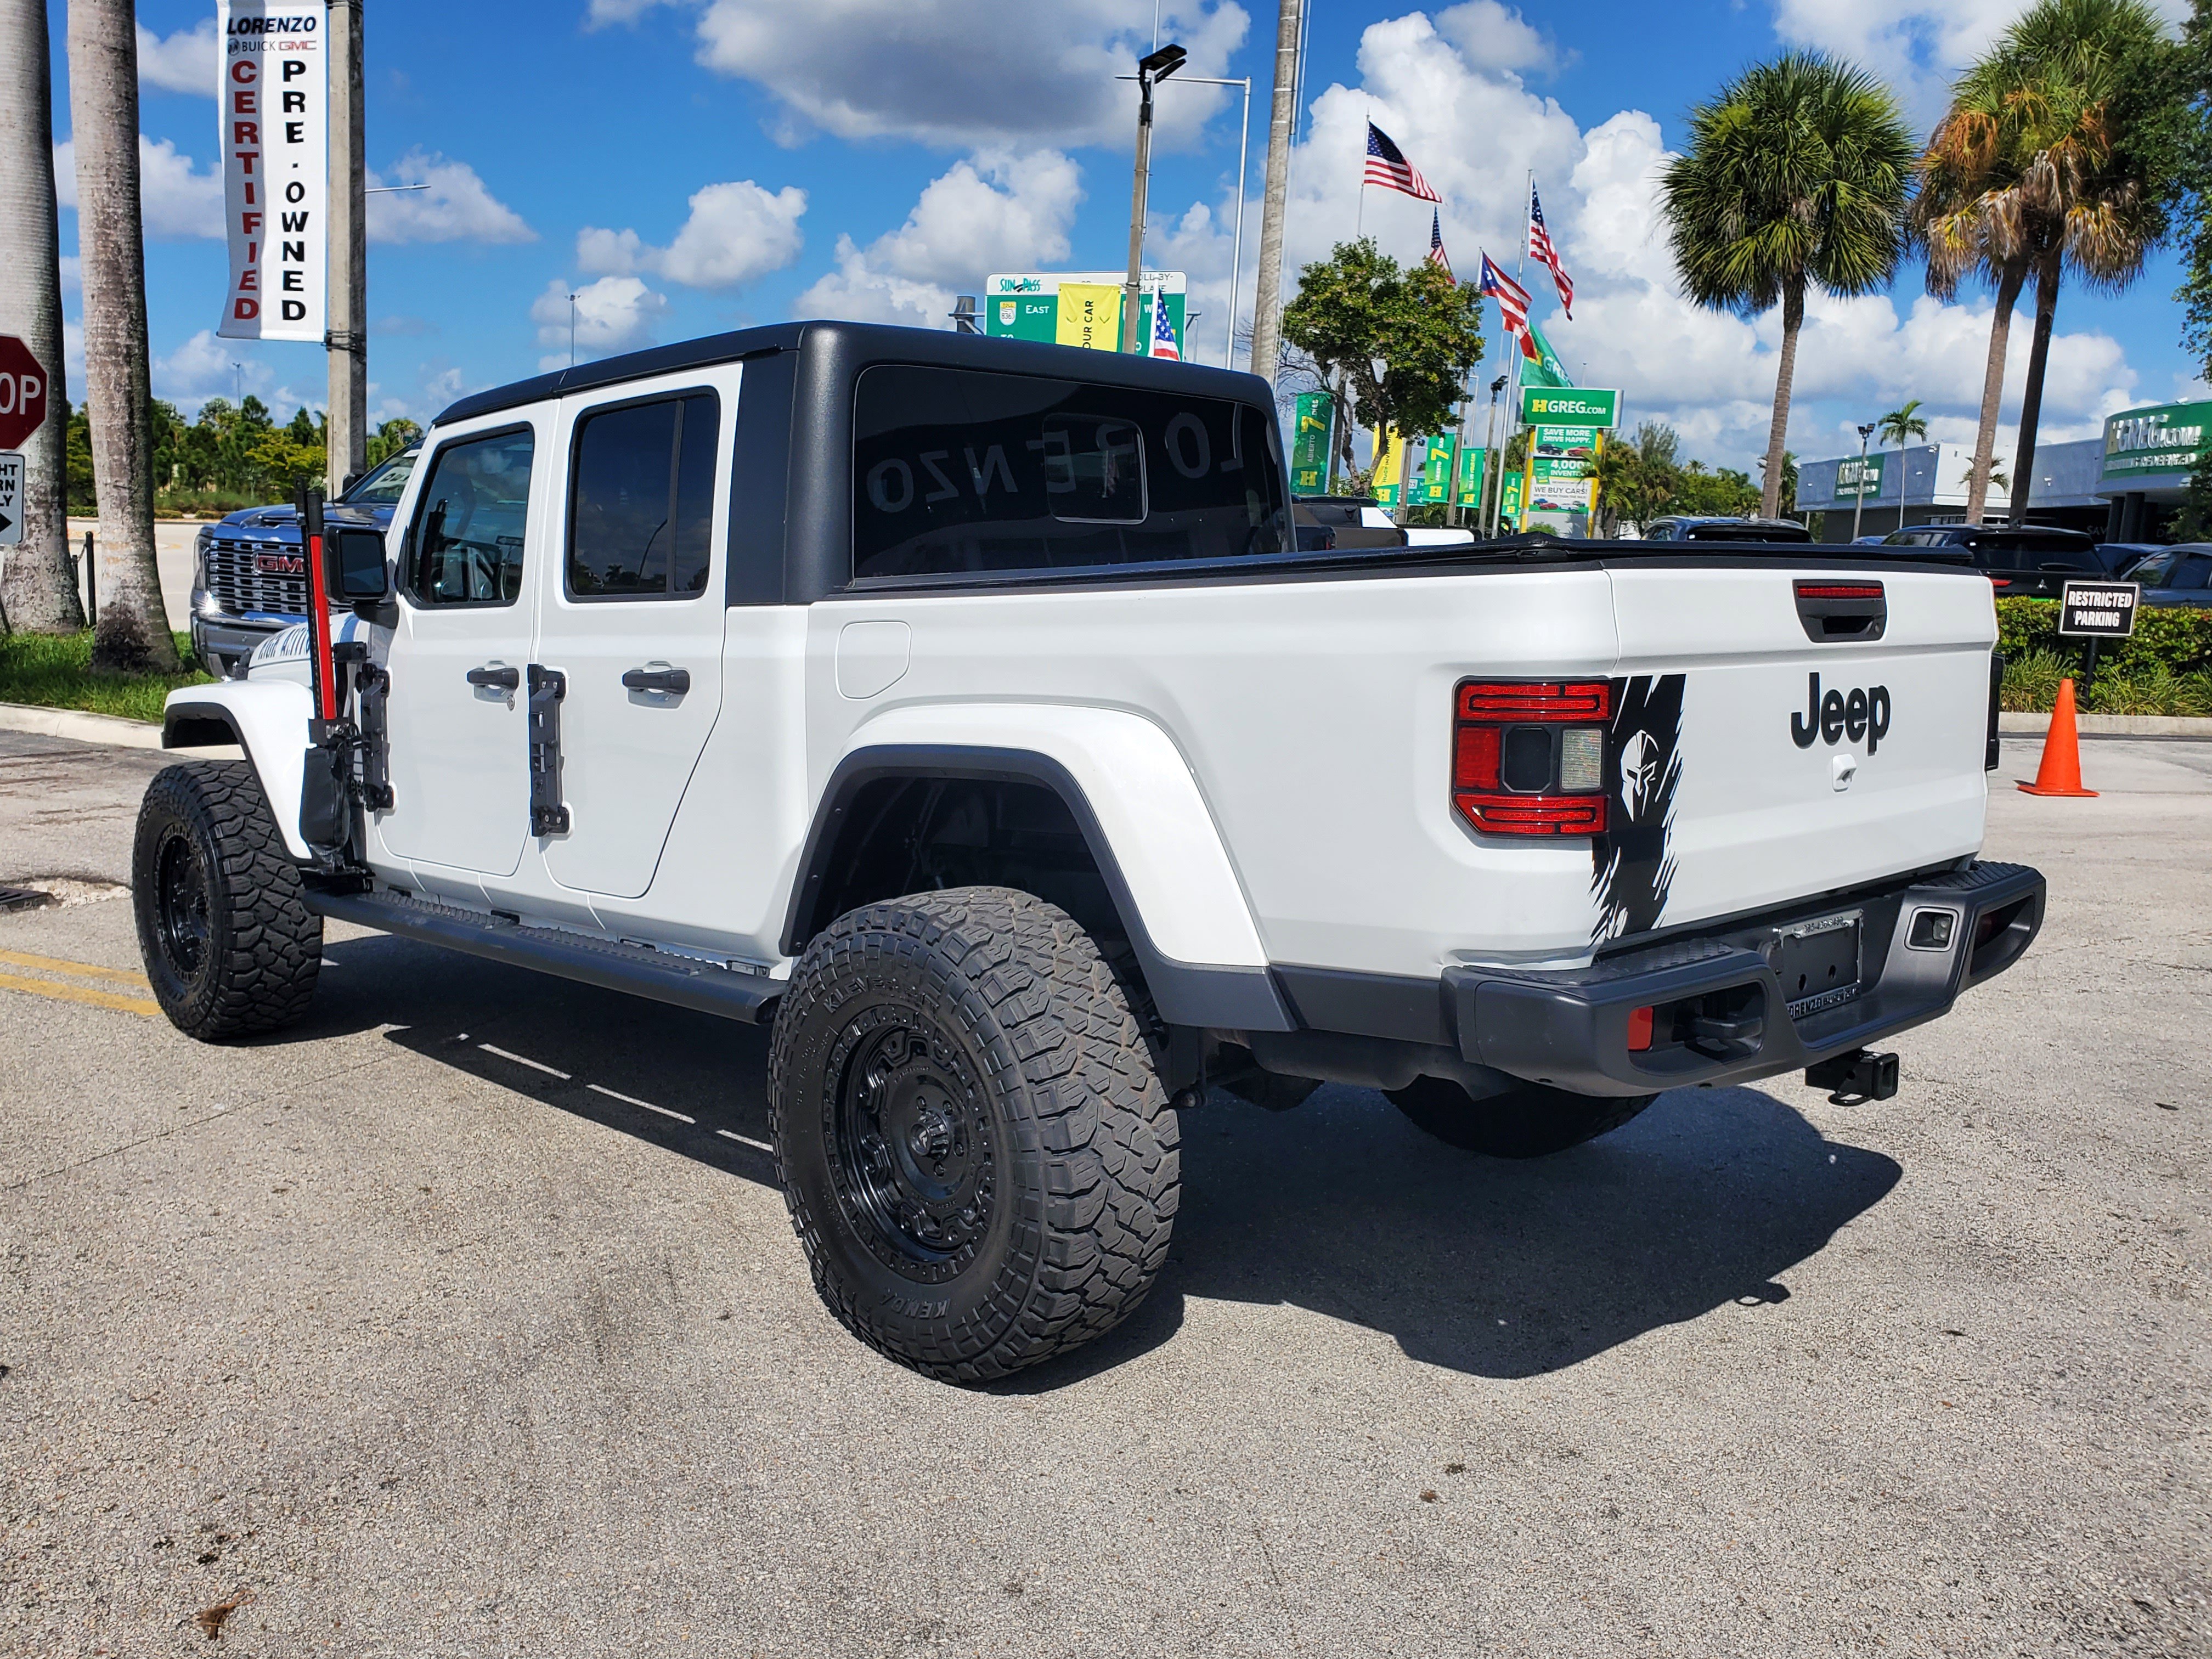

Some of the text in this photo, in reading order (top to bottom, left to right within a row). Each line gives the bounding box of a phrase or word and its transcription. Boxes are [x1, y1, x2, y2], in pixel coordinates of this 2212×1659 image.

[227, 16, 317, 34] LORENZO
[242, 40, 317, 52] BUICK GMC
[232, 60, 262, 320] CERTIFIED
[1025, 305, 1049, 314] EAST
[1082, 301, 1094, 349] OUR CAR
[0, 372, 41, 415] OP
[1532, 399, 1606, 414] HGREG.COM
[1301, 416, 1325, 432] 7
[1566, 429, 1592, 437] MORE.
[1307, 435, 1316, 462] ABIERTO
[1431, 448, 1449, 460] 7
[257, 555, 304, 573] GM
[2068, 591, 2132, 608] RESTRICTED
[2074, 611, 2120, 627] PARKING
[1791, 672, 1891, 757] Jeep
